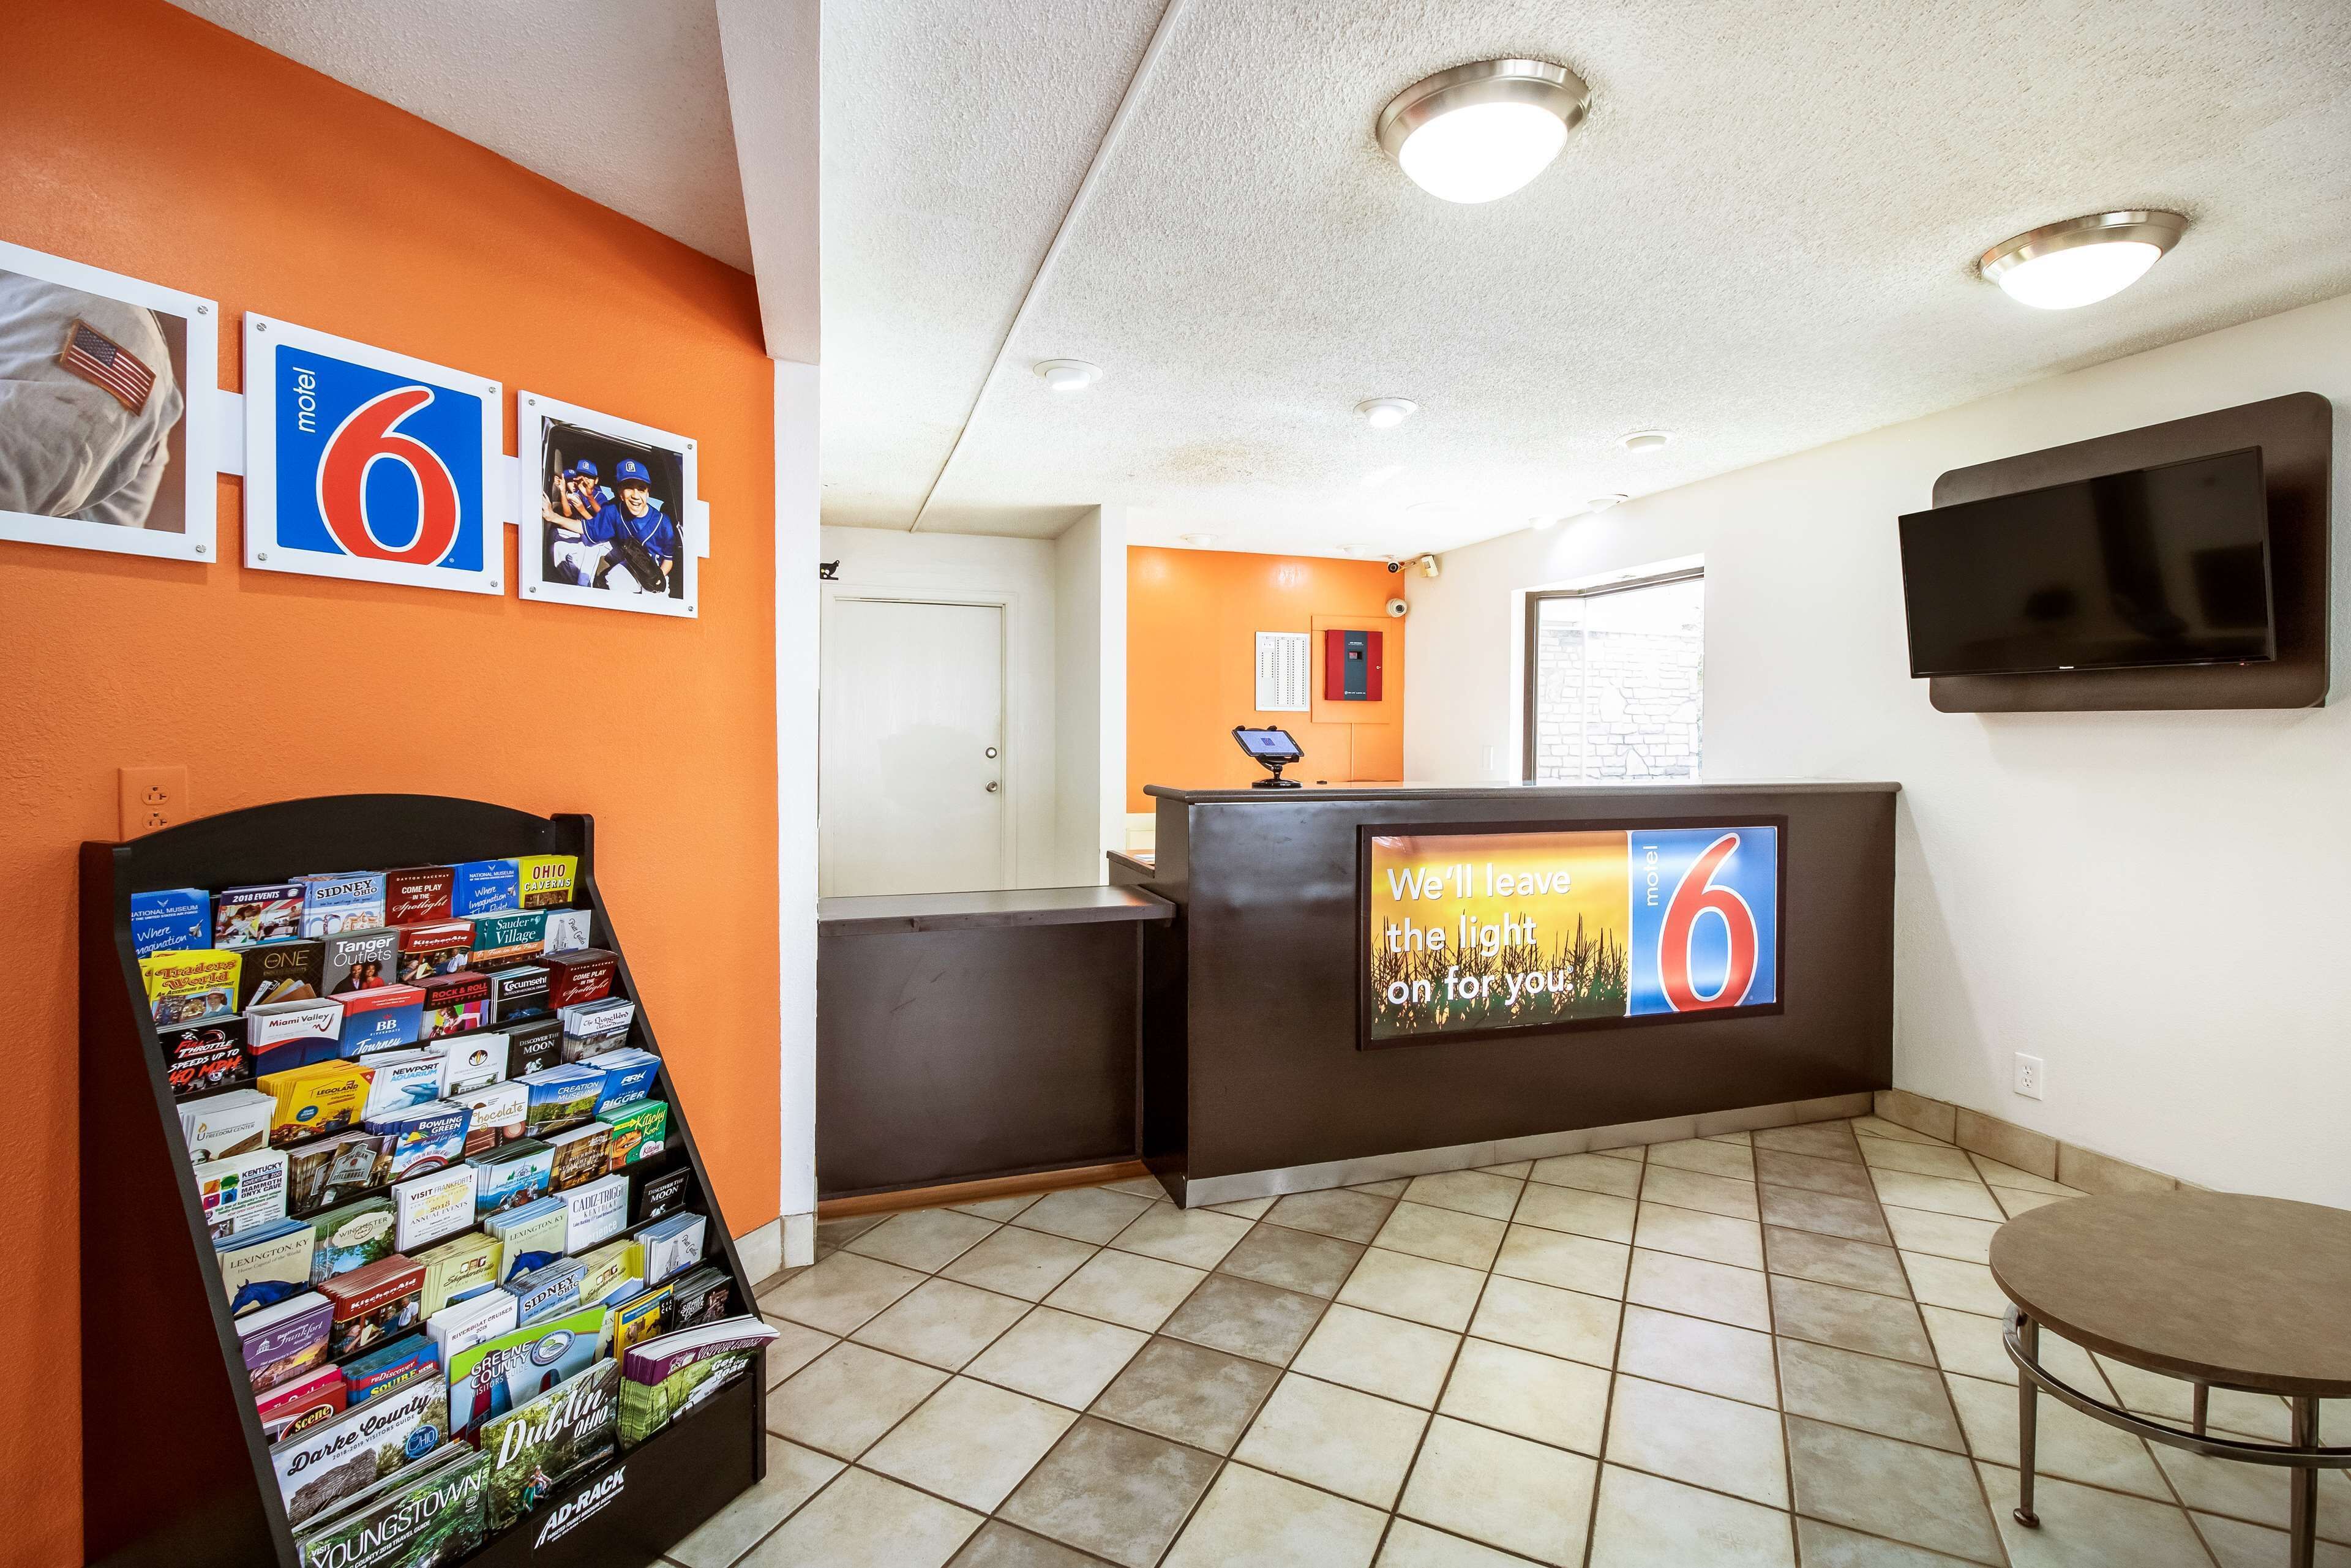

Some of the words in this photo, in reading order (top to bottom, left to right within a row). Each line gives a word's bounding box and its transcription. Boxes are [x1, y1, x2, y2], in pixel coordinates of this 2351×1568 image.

[293, 367, 315, 433] motel
[316, 385, 461, 566] 6
[626, 462, 636, 472] G
[533, 865, 566, 879] OHIO
[317, 879, 372, 899] SIDNEY
[402, 885, 422, 894] COME
[424, 884, 442, 893] PLAY
[524, 878, 571, 891] CAVERNS
[1387, 864, 1473, 901] We'll
[1488, 863, 1571, 897] leave
[233, 894, 253, 902] 2018
[254, 891, 280, 901] EVENTS
[353, 887, 377, 897] OHIO
[475, 887, 496, 897] Where
[392, 895, 448, 918] Spotlight
[470, 894, 506, 910] Imagination
[497, 918, 530, 931] Sauder
[1647, 846, 1659, 906] motel
[1657, 833, 1759, 1013] 6
[137, 926, 171, 942] Where
[413, 936, 468, 945] KitchenAid
[496, 929, 536, 944] Village
[1387, 918, 1446, 953] the
[1460, 914, 1537, 957] light
[337, 937, 395, 954] Tanger
[264, 950, 310, 969] ONE
[334, 948, 392, 967] Outlets
[155, 960, 237, 979] Traders
[591, 969, 606, 978] PLAY
[162, 971, 230, 989] World
[504, 977, 547, 992] Tecumseh!
[1387, 980, 1431, 1005] on
[1444, 966, 1497, 1001] for
[432, 988, 459, 999] ROCK
[468, 982, 487, 992] ROLL
[563, 978, 609, 1002] Spotlight
[269, 1017, 299, 1027] Miami
[301, 1013, 329, 1023] Valley
[376, 1020, 397, 1031] BB
[174, 1040, 204, 1054] FULL
[519, 1034, 549, 1046] DISCOVER
[523, 1040, 555, 1055] MOON
[178, 1040, 233, 1059] THROTTLE
[168, 1056, 209, 1073] SPEEDS
[212, 1052, 225, 1061] UP
[227, 1048, 239, 1057] TO
[169, 1068, 195, 1086] 40
[198, 1056, 242, 1077] MPH
[390, 1069, 437, 1082] AQUARIUM
[392, 1063, 439, 1076] NEWPORT
[621, 1070, 647, 1084] ARK
[317, 1082, 358, 1095] LEGOLAND
[557, 1089, 594, 1101] MUSEUM
[558, 1081, 599, 1095] CREATION
[601, 1090, 645, 1109] BIGGER
[419, 1116, 462, 1130] BOWLING
[635, 1107, 666, 1130] Kitschy
[205, 1128, 233, 1139] FREEDOM
[233, 1123, 255, 1132] CENTER
[432, 1122, 461, 1133] GREEN
[643, 1121, 660, 1138] Kool
[242, 1161, 283, 1178] KENTUCKY
[241, 1178, 282, 1193] MAMMOTH
[243, 1174, 269, 1185] ADVENTURE
[411, 1188, 433, 1200] VISIT
[434, 1174, 472, 1193] FRANKFORT!
[648, 1182, 674, 1195] DISCOVER
[673, 1177, 684, 1186] THE
[241, 1188, 261, 1198] ONYX
[263, 1183, 282, 1191] CAVE
[573, 1185, 621, 1213] CADIZ-TRIGG
[650, 1185, 679, 1202] MOON
[411, 1212, 440, 1225] ANNUAL
[441, 1201, 468, 1214] EVENTS
[430, 1201, 451, 1212] 2018
[584, 1199, 617, 1218] KENTUCKY
[554, 1215, 564, 1223] KY
[339, 1217, 388, 1239] WINCHESTER
[296, 1238, 309, 1247] KY
[351, 1278, 416, 1310] KitchenAid
[525, 1274, 574, 1311] SIDNEY
[558, 1281, 579, 1296] OHIO
[277, 1323, 309, 1341] Destination
[452, 1318, 486, 1340] RIVERBOAT
[487, 1307, 513, 1322] CRUISES
[476, 1324, 488, 1334] 2018
[280, 1321, 323, 1345] Frankfort
[471, 1340, 533, 1376] GREENE
[711, 1356, 736, 1371] Get
[470, 1352, 530, 1390] COUNTY
[712, 1359, 749, 1384] Road
[470, 1376, 503, 1398] VISITORS
[506, 1364, 529, 1379] GUIDE
[497, 1389, 608, 1470] Dublin,
[574, 1405, 609, 1438] OHIO
[287, 1430, 360, 1477] Darke
[360, 1394, 432, 1435] County
[332, 1441, 364, 1460] 2018-2019
[366, 1425, 394, 1442] VISITORS
[396, 1414, 415, 1427] GUIDE
[534, 1465, 626, 1550] AD-RACK
[312, 1468, 482, 1568] YOUNGSTOWN
[312, 1542, 332, 1557] VISIT
[354, 1550, 380, 1568] COUNTY
[380, 1543, 392, 1553] 2018
[392, 1532, 414, 1546] TRAVEL
[414, 1519, 432, 1534] GUIDE
